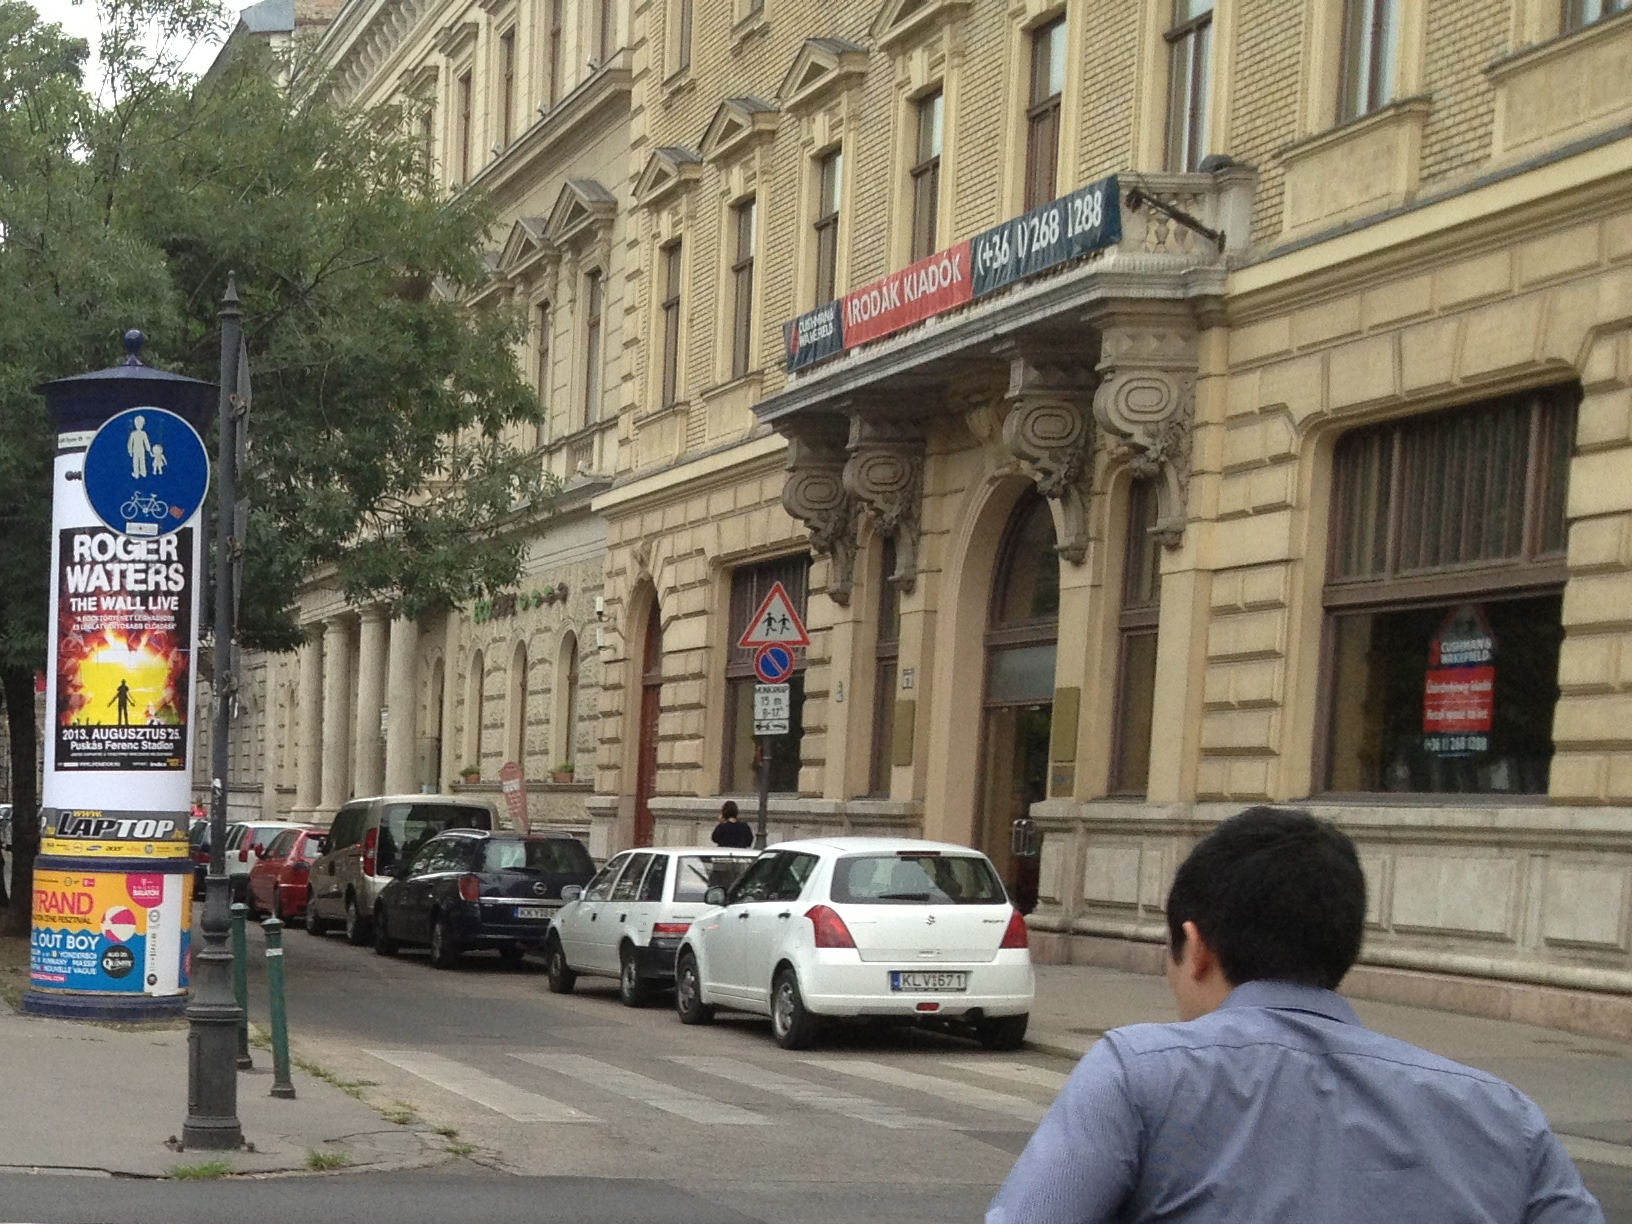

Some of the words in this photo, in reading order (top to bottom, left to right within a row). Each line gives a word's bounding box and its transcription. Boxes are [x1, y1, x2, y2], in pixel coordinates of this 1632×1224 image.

[1031, 208, 1060, 252] 268
[1068, 190, 1103, 238] 1288
[848, 284, 901, 327] IRODÁK
[903, 252, 963, 302] KIADÓK
[73, 532, 179, 562] ROGER
[66, 563, 185, 593] WATERS
[70, 597, 97, 612] THE
[100, 596, 145, 611] WALL
[148, 596, 179, 611] LIVE
[62, 729, 89, 740] 2013.
[92, 728, 167, 740] AUGUSZTUS
[70, 741, 103, 751] Puskás
[105, 740, 139, 751] Ferenc
[141, 740, 174, 750] Stadion
[57, 811, 175, 839] LAPTOP
[39, 933, 63, 948] OUT
[66, 935, 100, 950] BOY
